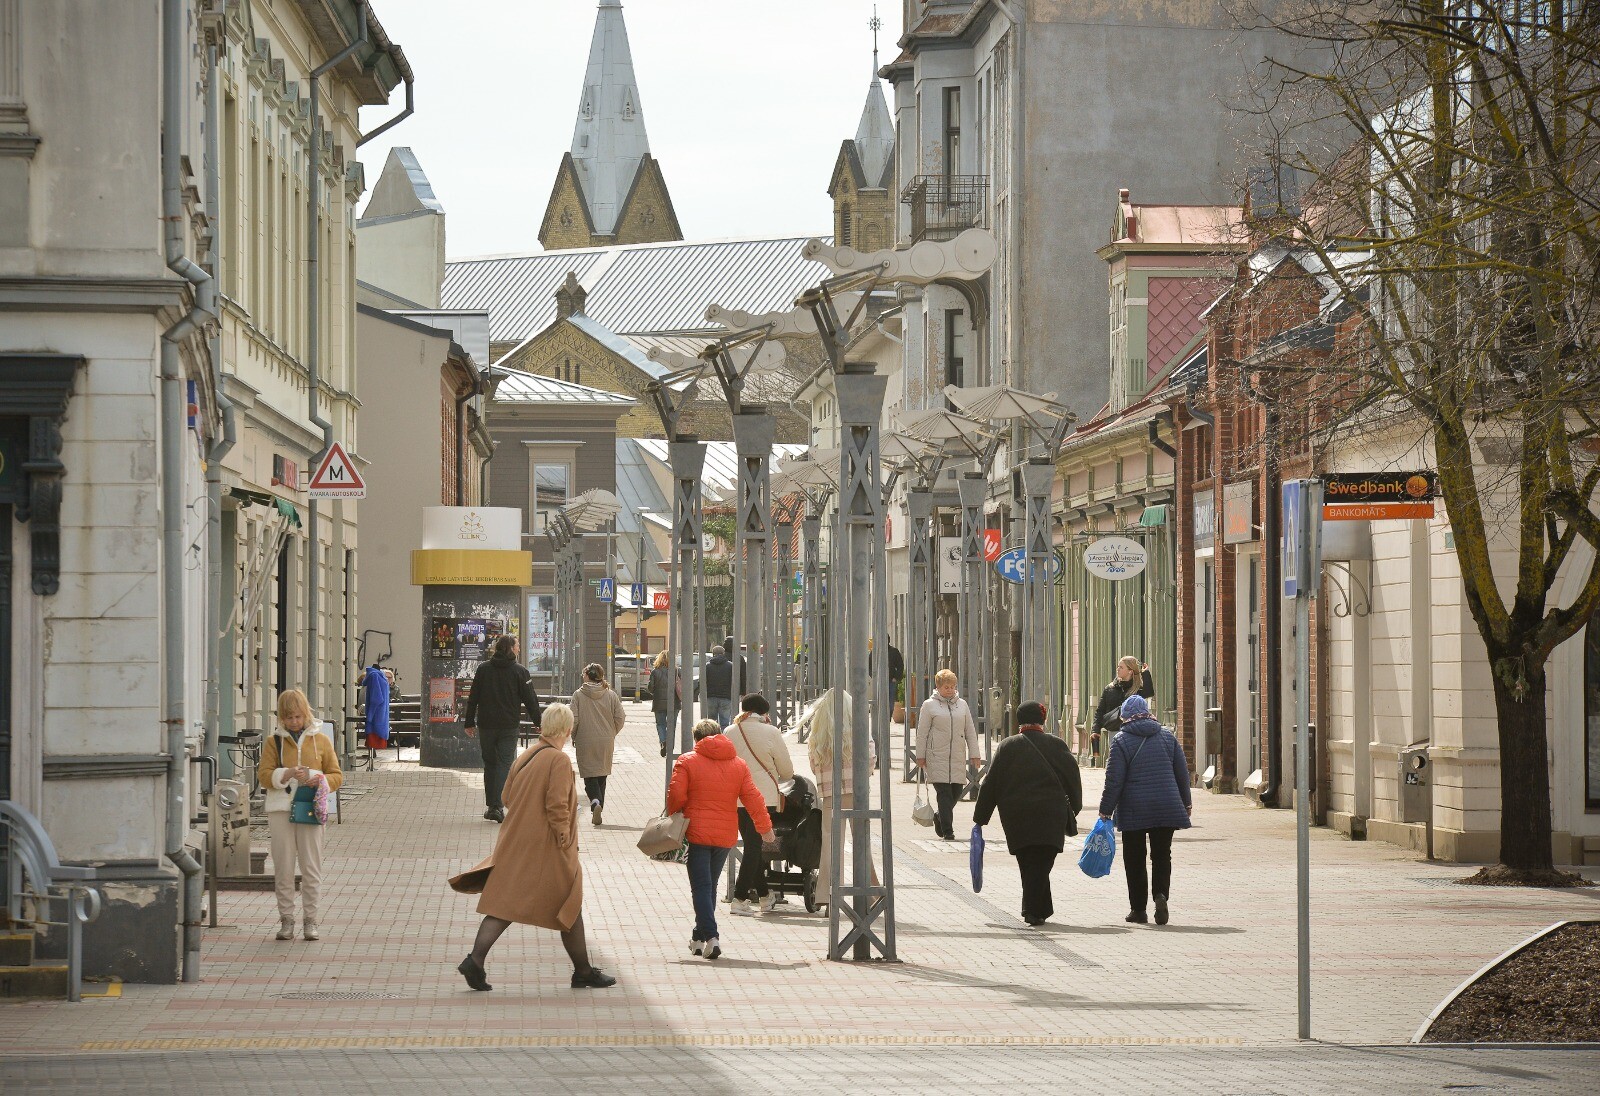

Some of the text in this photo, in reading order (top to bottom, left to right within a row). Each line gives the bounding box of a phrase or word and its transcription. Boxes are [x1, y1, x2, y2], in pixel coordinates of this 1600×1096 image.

[330, 465, 343, 481] M
[1329, 480, 1403, 495] Swedbank
[1329, 506, 1386, 517] BANKOMĀTS
[984, 534, 999, 558] ly
[1004, 559, 1059, 574] FOO
[655, 594, 669, 609] illy
